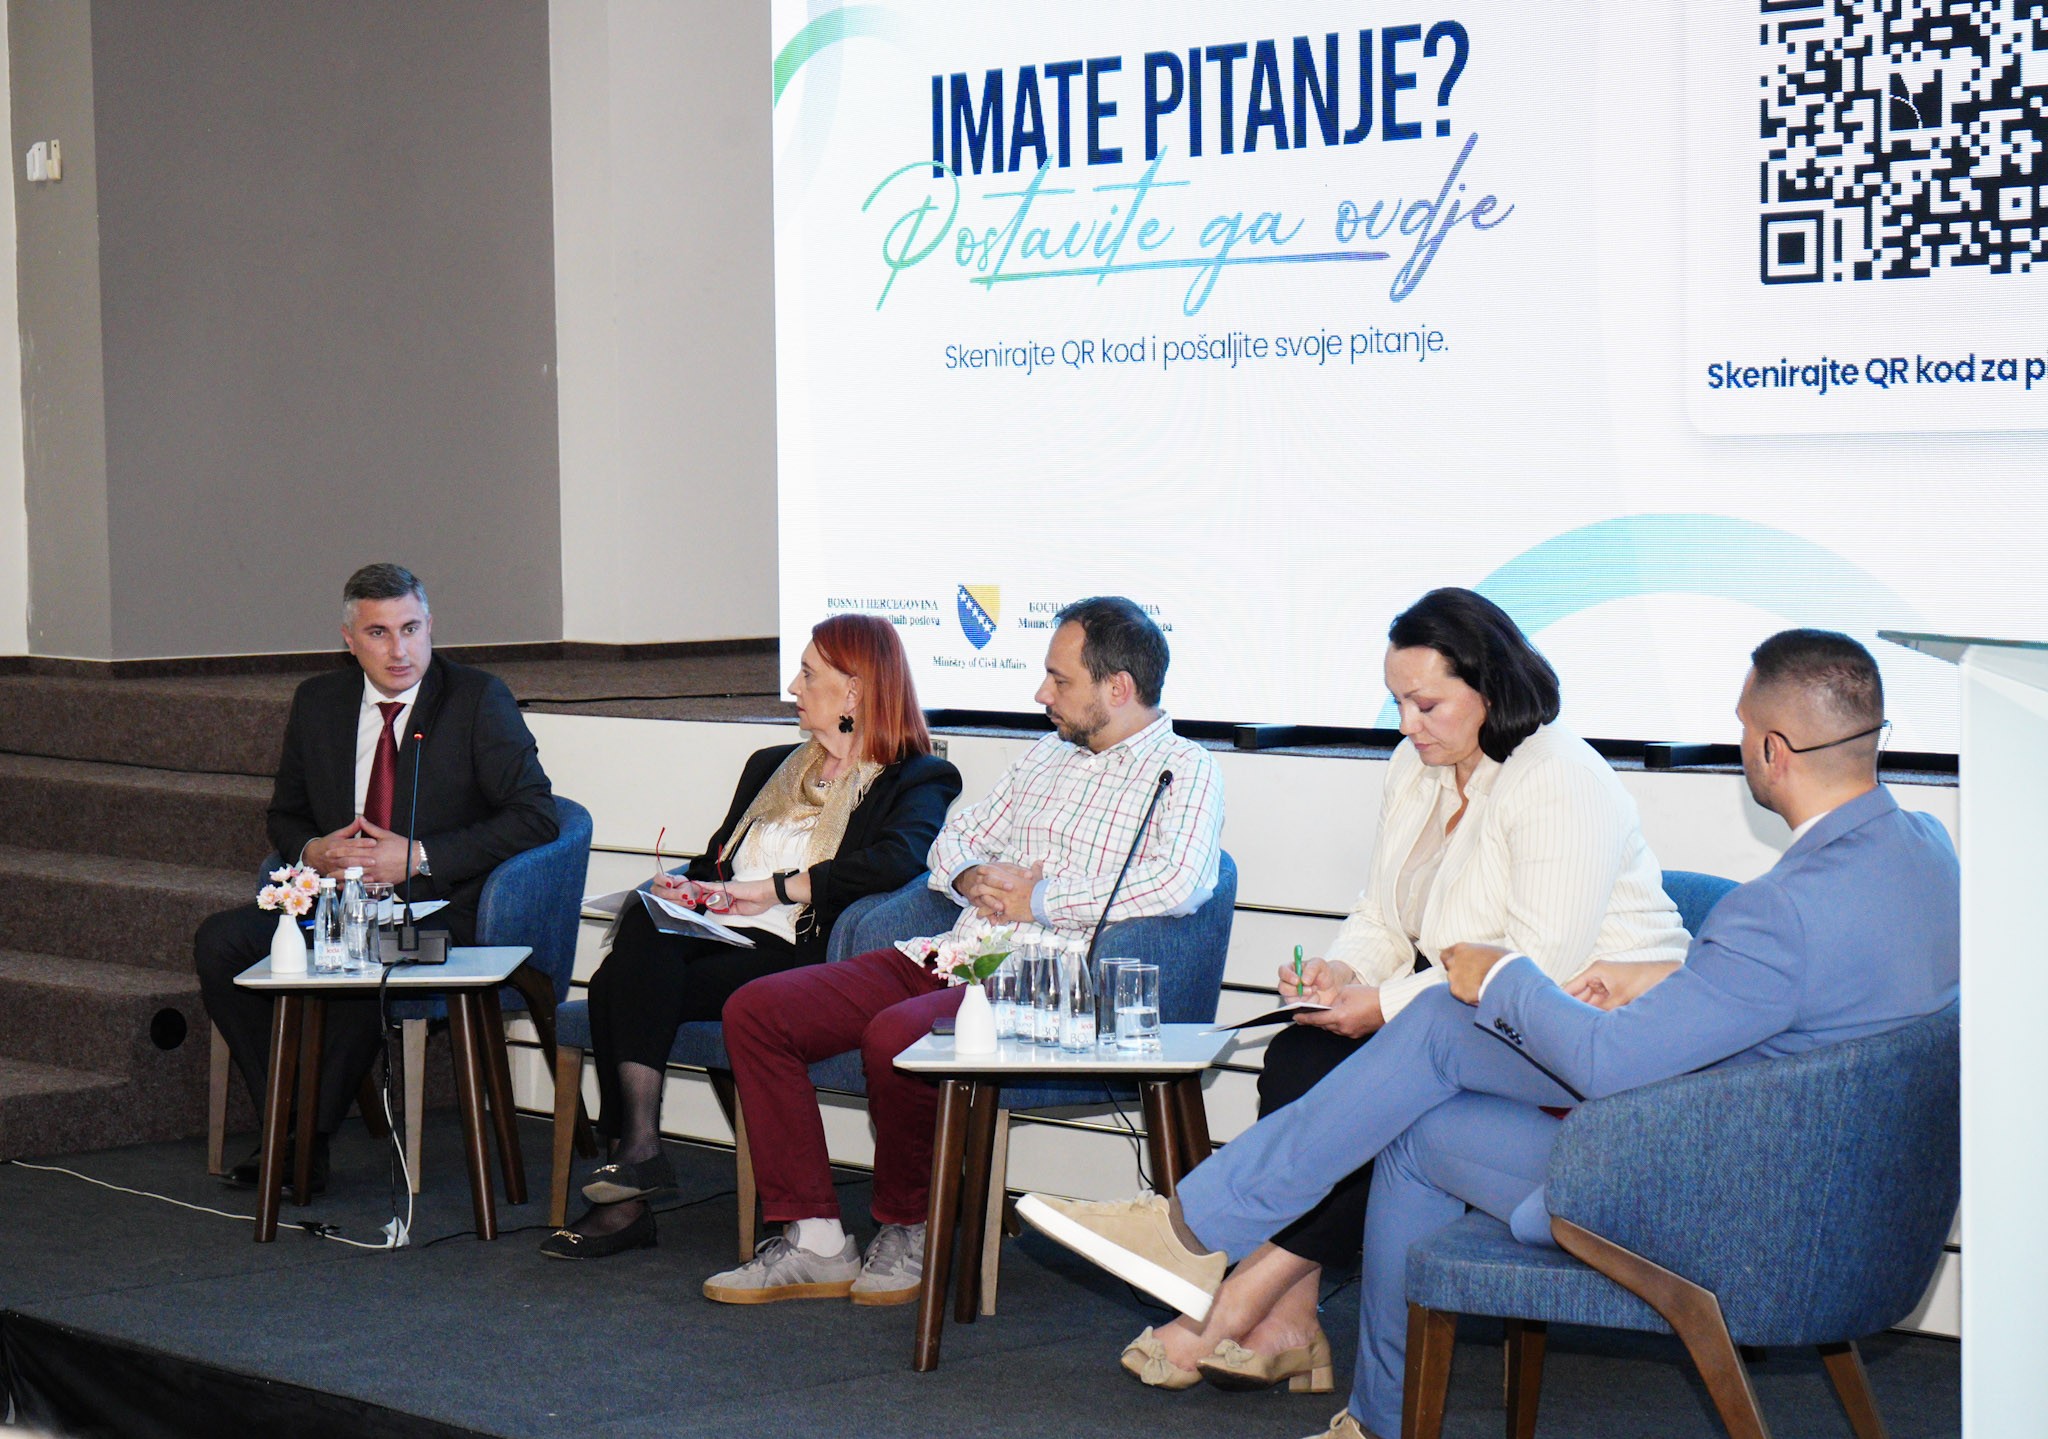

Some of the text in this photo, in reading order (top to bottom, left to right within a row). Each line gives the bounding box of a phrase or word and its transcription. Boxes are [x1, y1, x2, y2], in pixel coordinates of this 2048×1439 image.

[931, 20, 1471, 178] IMATE PITANJE?
[862, 132, 1516, 316] Postavite ga ovdje
[945, 323, 1450, 376] Skenirajte QR kod i pošaljite svoje pitanje.
[1708, 352, 2048, 395] Skenirajte QR kod za p
[827, 597, 859, 609] BOSNA
[866, 598, 939, 611] HERCEGOVINA
[910, 614, 941, 627] poslova
[933, 656, 1027, 669] Ministry of Civil Affairs
